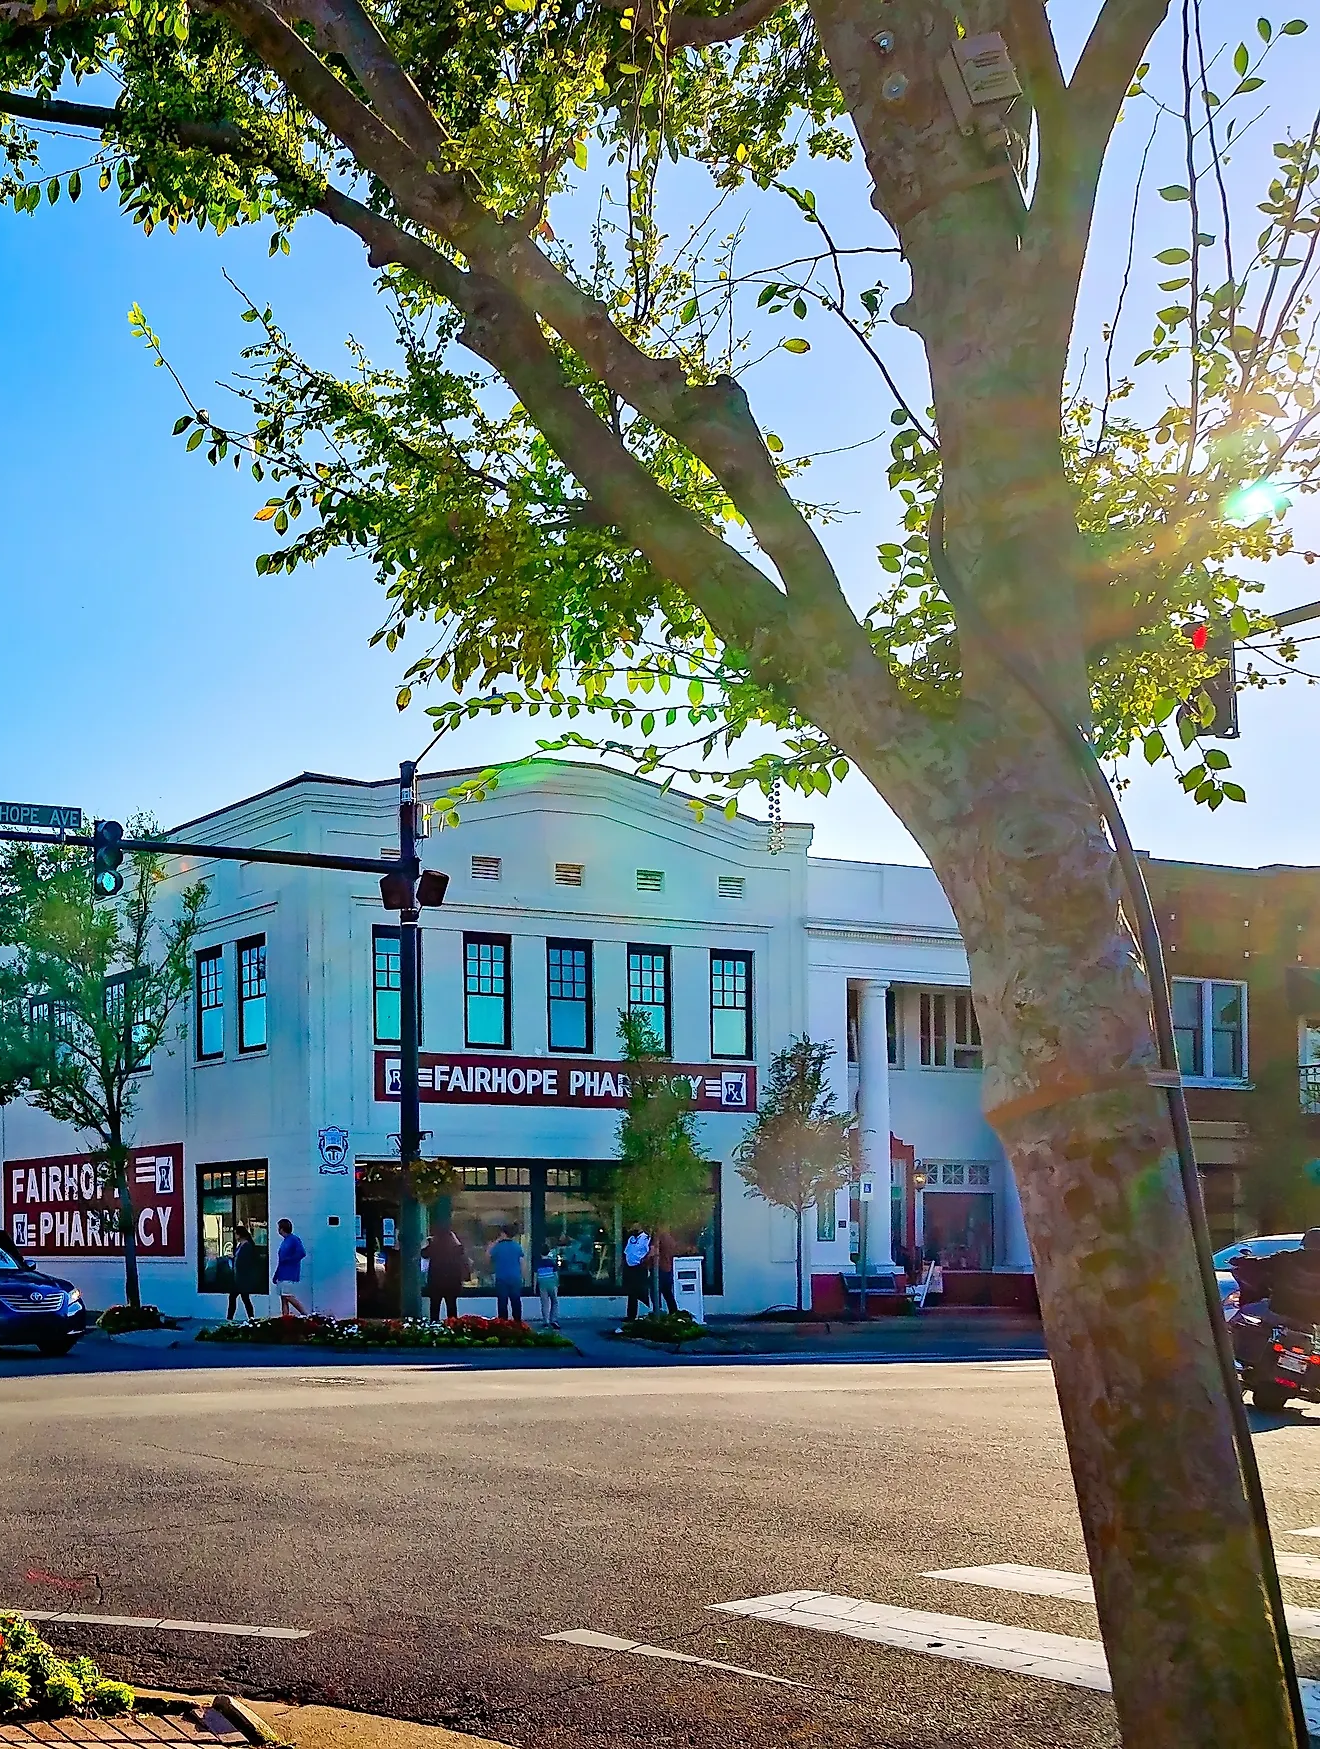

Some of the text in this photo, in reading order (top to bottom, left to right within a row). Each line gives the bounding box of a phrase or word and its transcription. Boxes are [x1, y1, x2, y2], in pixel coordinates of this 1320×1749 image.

[49, 810, 79, 826] AVE
[434, 1065, 558, 1095] FAIRHOPE
[40, 1206, 172, 1246] PHARMCY
